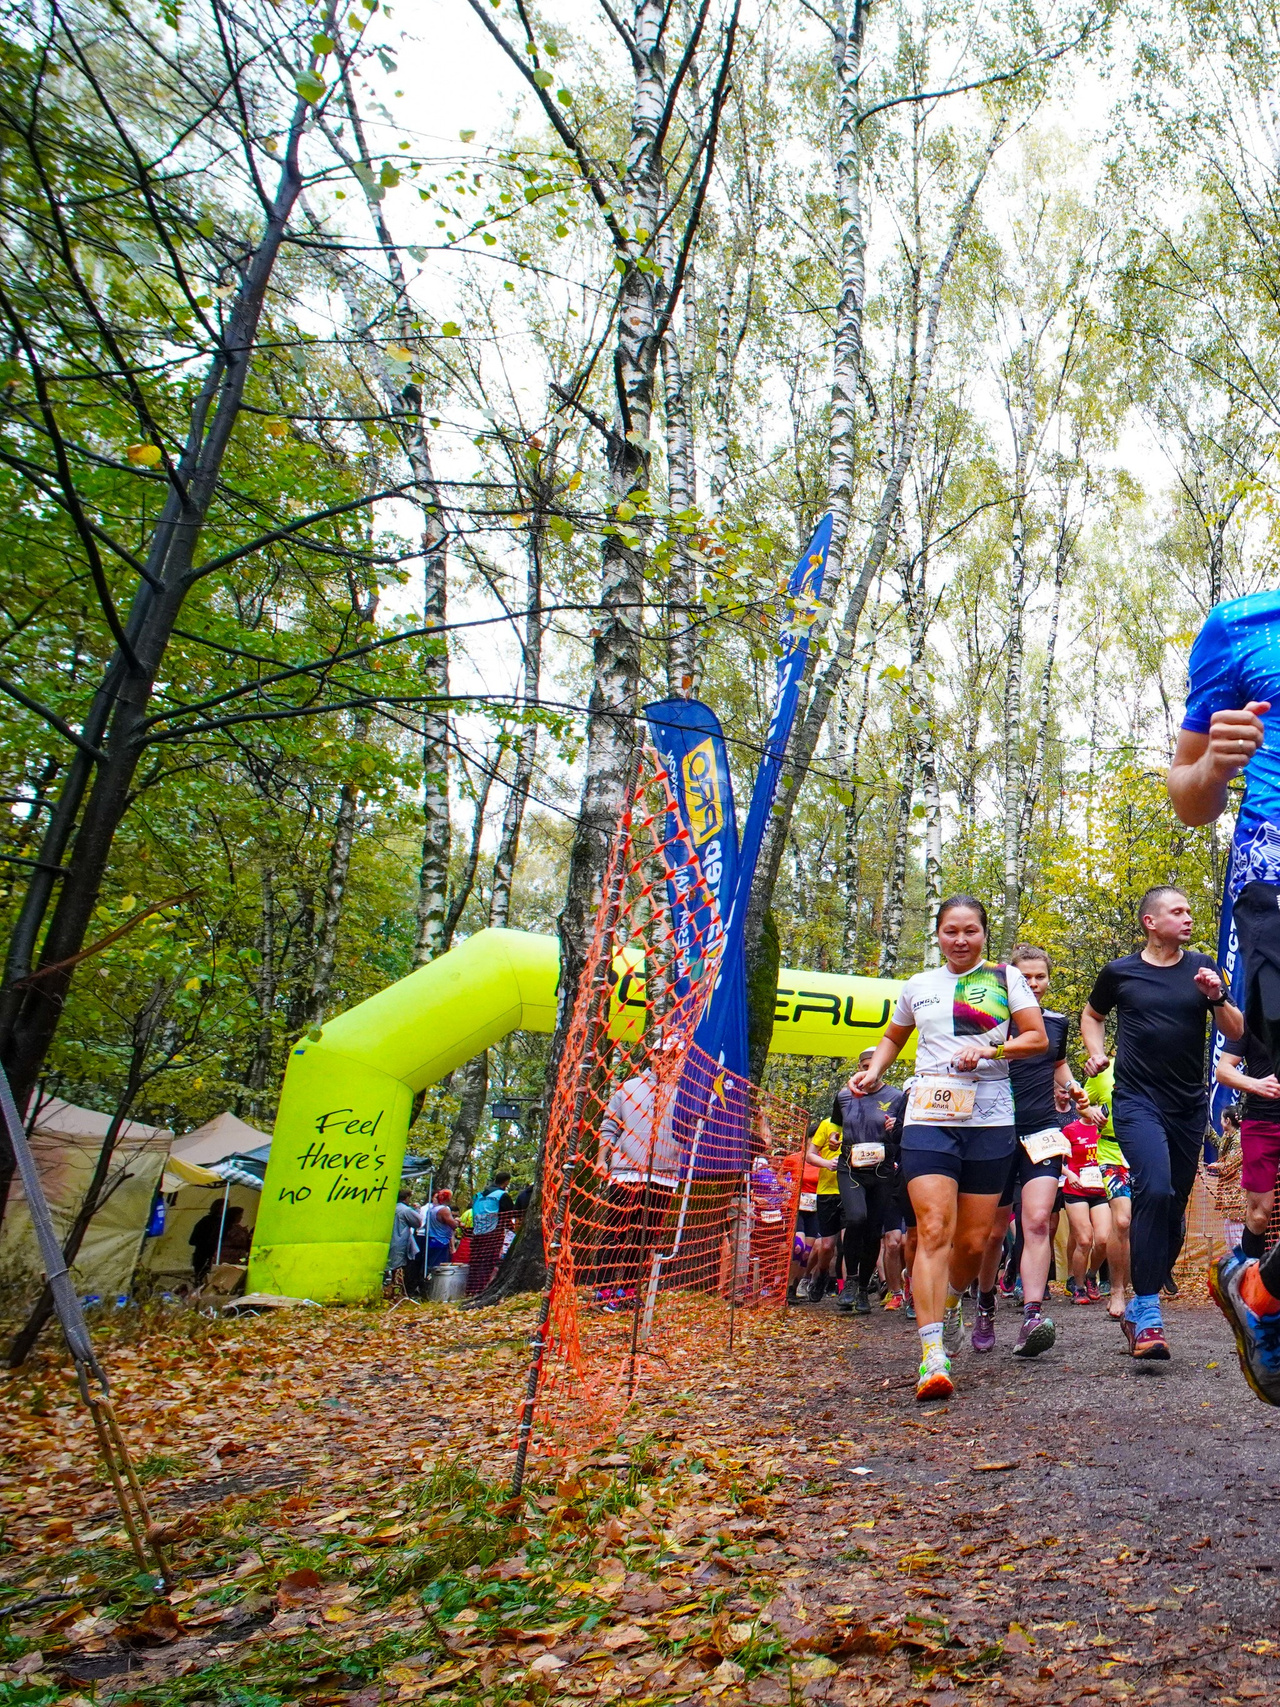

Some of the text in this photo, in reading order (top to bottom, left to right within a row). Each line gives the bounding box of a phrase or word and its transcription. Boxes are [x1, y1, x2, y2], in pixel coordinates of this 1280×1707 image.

[934, 1089, 952, 1102] 60
[315, 1108, 384, 1137] Feel
[1042, 1134, 1057, 1144] 91
[296, 1142, 387, 1171] there's
[278, 1174, 389, 1205] no limit
